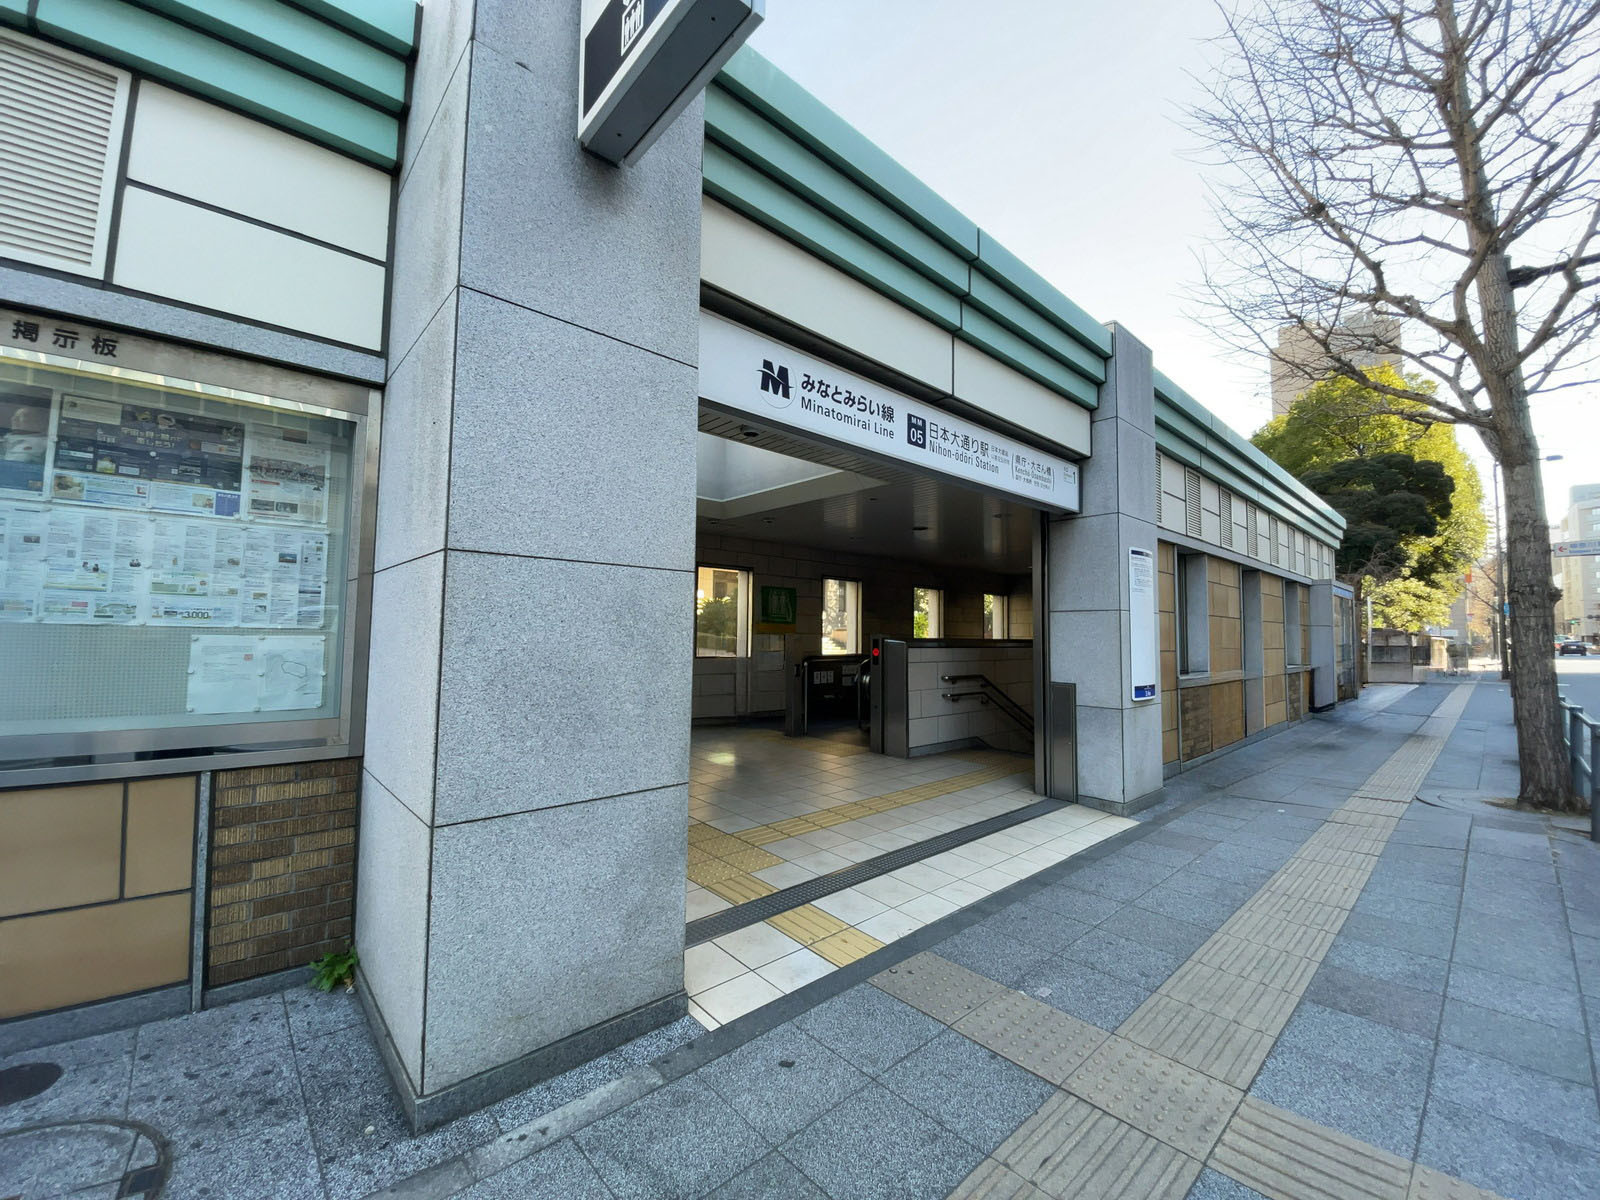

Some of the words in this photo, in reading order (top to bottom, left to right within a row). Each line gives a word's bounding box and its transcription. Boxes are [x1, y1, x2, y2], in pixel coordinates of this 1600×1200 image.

[12, 319, 120, 358] 掲示板
[801, 373, 895, 424] みなとみらい線
[801, 396, 870, 431] Minatomirai
[874, 421, 895, 439] Line
[910, 428, 923, 444] 05
[911, 416, 923, 426] MM
[929, 421, 989, 458] 日本大通り駅
[975, 456, 999, 474] Station
